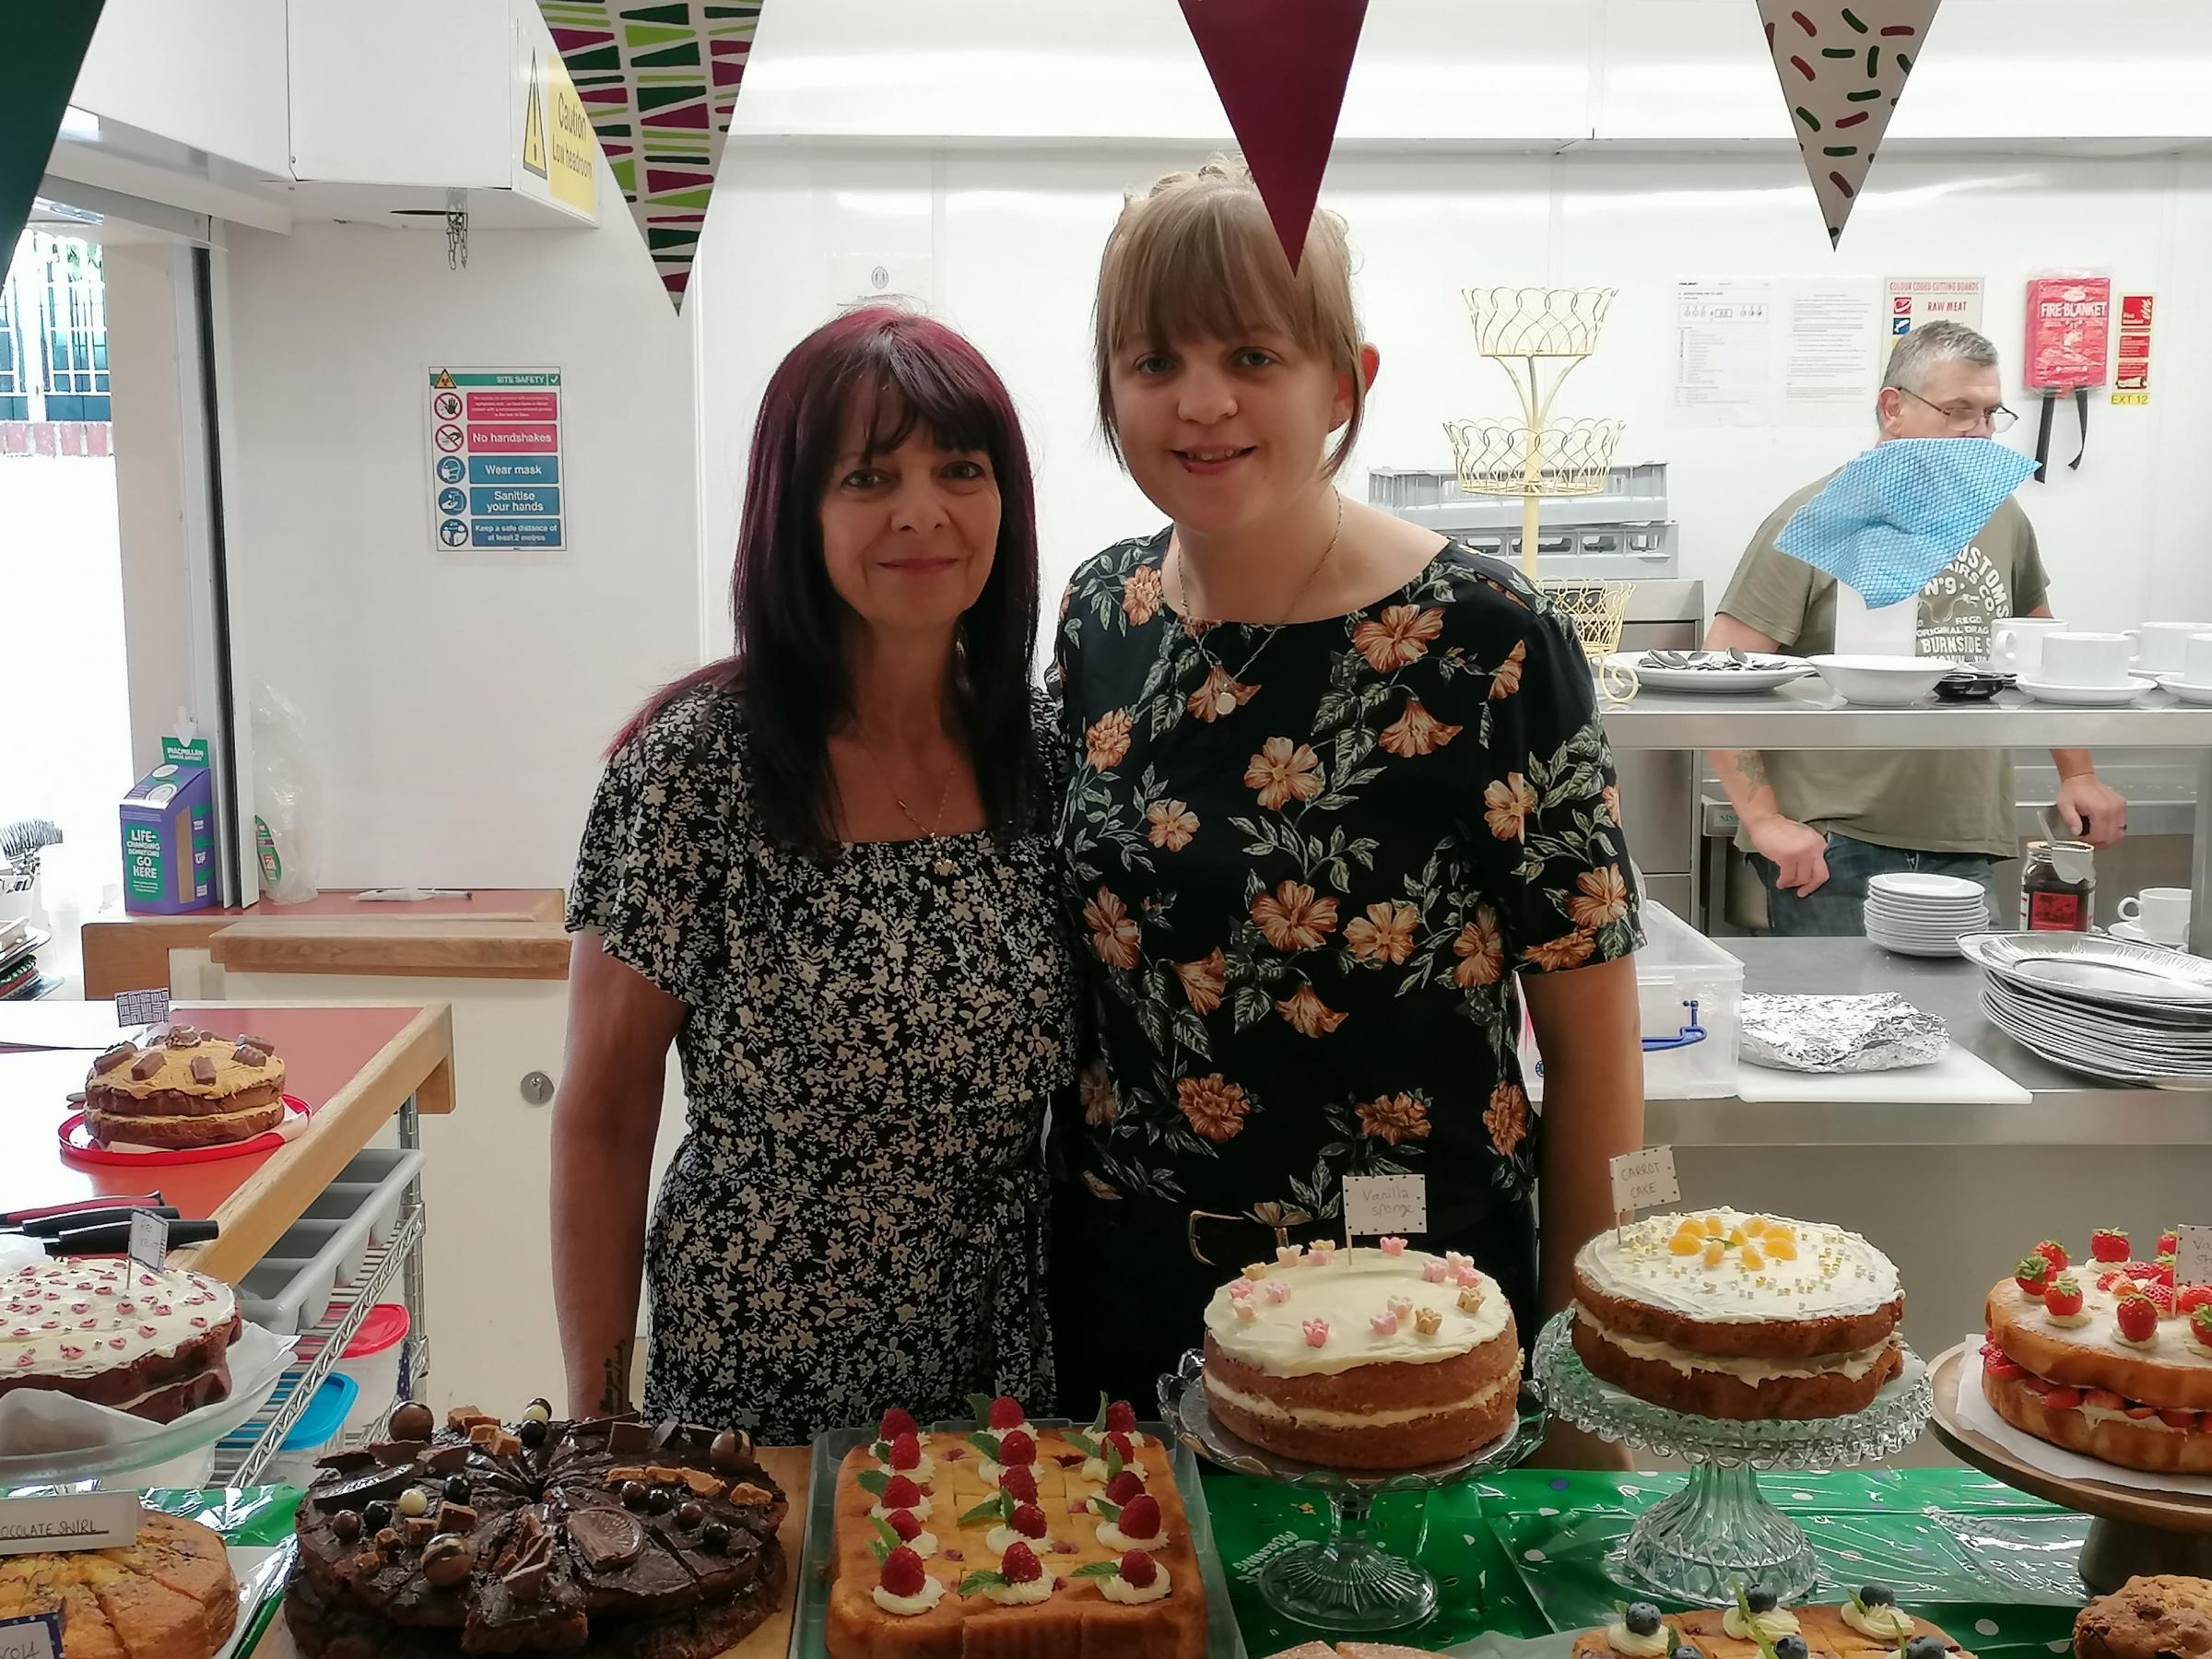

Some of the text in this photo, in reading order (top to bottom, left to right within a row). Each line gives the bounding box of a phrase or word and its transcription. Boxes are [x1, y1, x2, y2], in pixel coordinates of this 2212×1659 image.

[558, 92, 587, 143] Caution
[553, 134, 593, 179] Low headroom
[1927, 301, 1967, 312] RAW MEAT
[2041, 301, 2108, 318] FIRE BLANKET
[2111, 394, 2148, 406] EXT 12
[472, 432, 552, 442] No handshakes
[485, 465, 542, 475] Wear mask
[494, 490, 535, 500] Sanitise
[487, 501, 544, 513] your hands
[475, 524, 494, 533] Keep
[1958, 543, 2009, 618] USTOMS
[1916, 627, 1964, 638] ORIGINAL
[1921, 636, 1983, 653] BURNSIDE
[136, 856, 152, 866] GO
[133, 865, 158, 878] HERE
[1621, 1162, 1660, 1181] CARROT
[1363, 1185, 1409, 1200] Vanilla
[1630, 1182, 1657, 1198] CAKE
[0, 1519, 96, 1537] OCOLATE SWIRL
